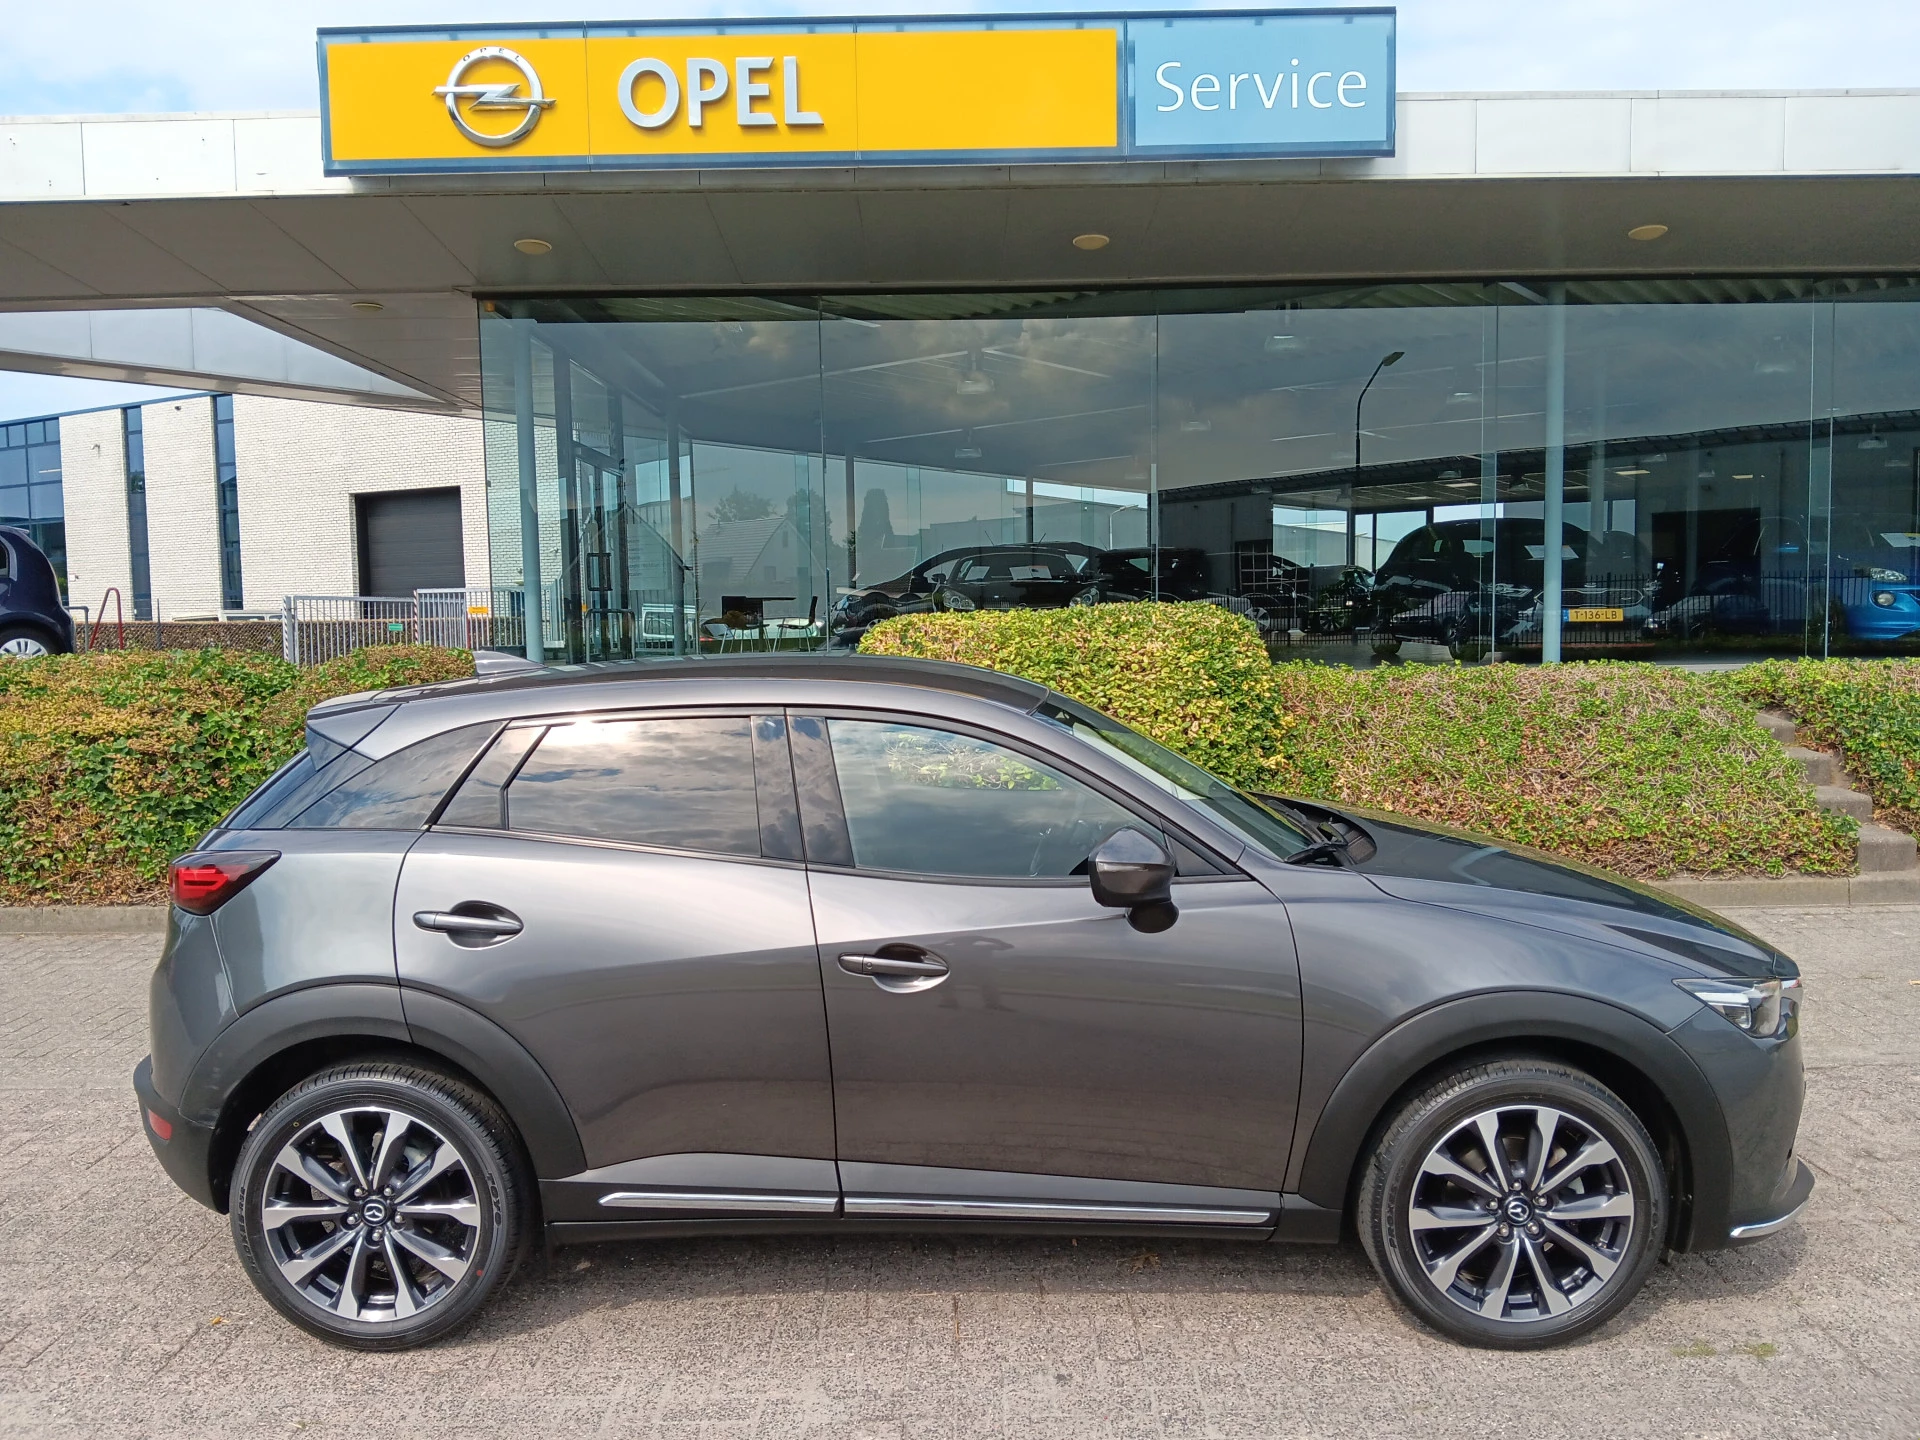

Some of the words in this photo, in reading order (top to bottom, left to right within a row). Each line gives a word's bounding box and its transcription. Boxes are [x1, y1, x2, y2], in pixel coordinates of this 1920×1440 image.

[463, 47, 520, 62] OPEL
[617, 56, 825, 128] OPEL
[1154, 58, 1368, 112] Service
[1573, 610, 1618, 620] T-136-LB
[486, 1172, 502, 1227] TOYO
